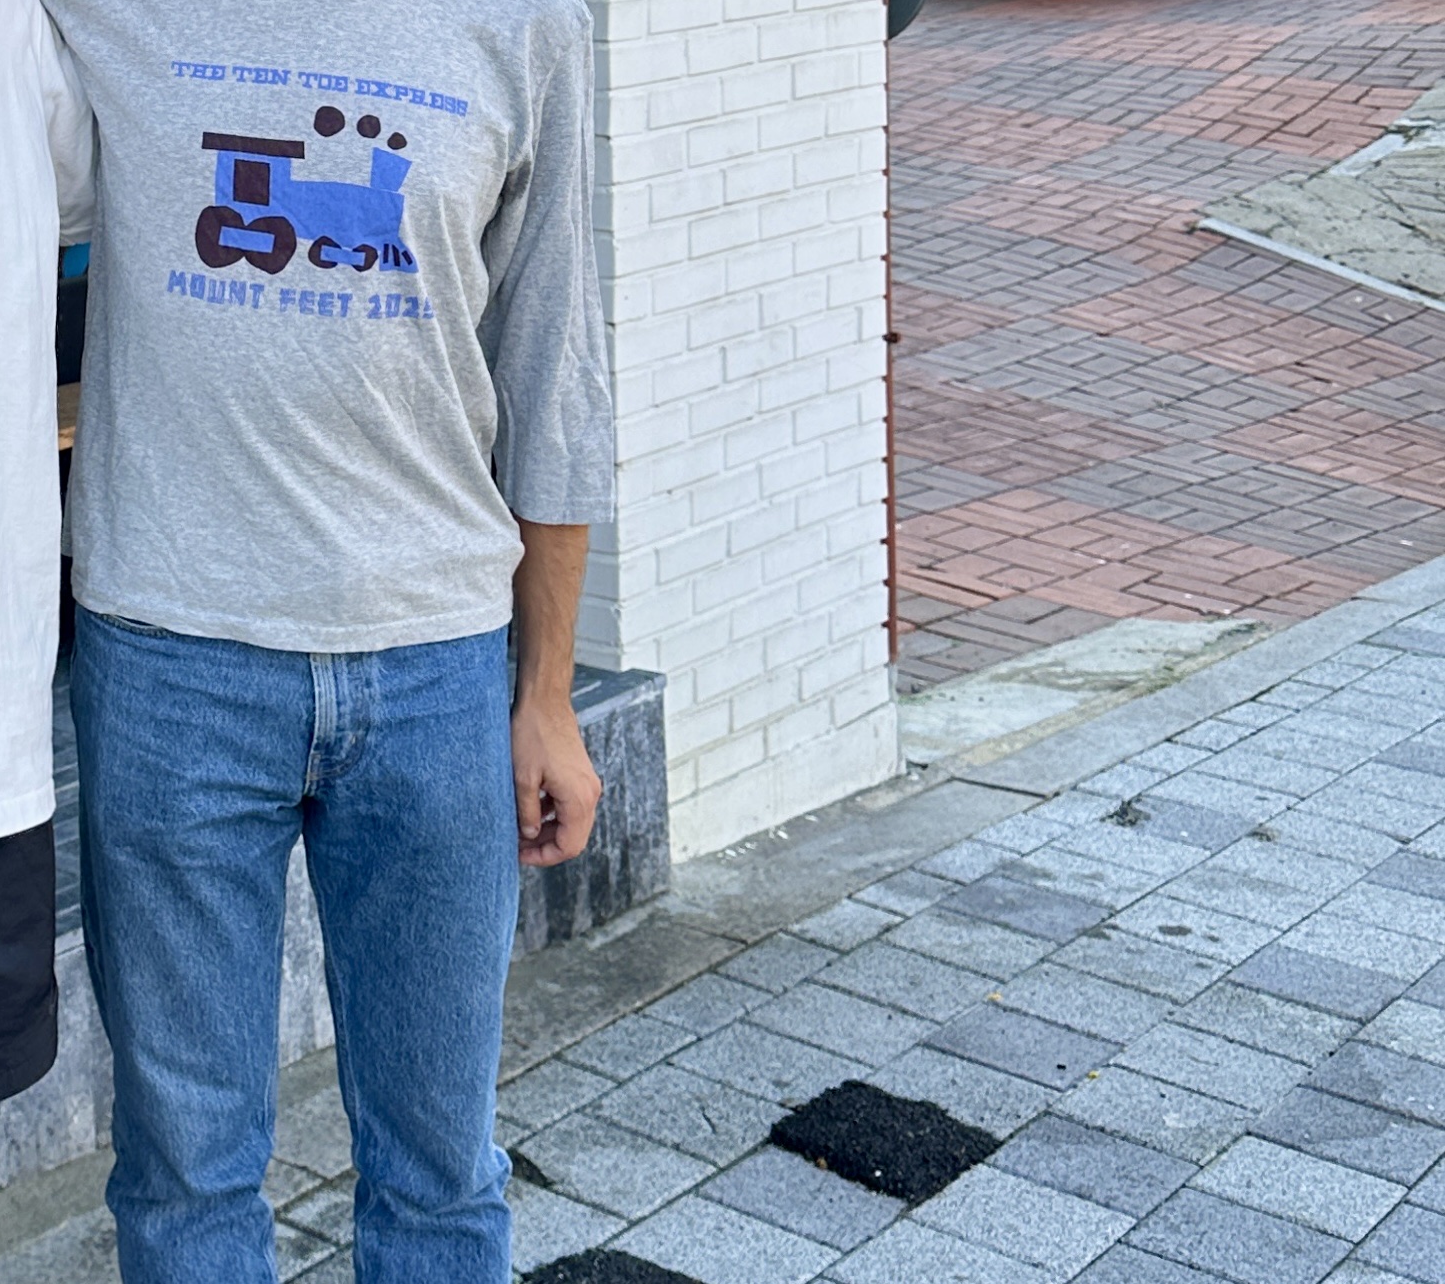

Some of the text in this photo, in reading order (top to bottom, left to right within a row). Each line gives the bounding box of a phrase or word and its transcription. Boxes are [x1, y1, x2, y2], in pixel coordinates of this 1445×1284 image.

[171, 61, 468, 116] THE TEN TOE EXPRESS
[167, 270, 265, 309] MOUNT
[279, 288, 353, 318] FEET
